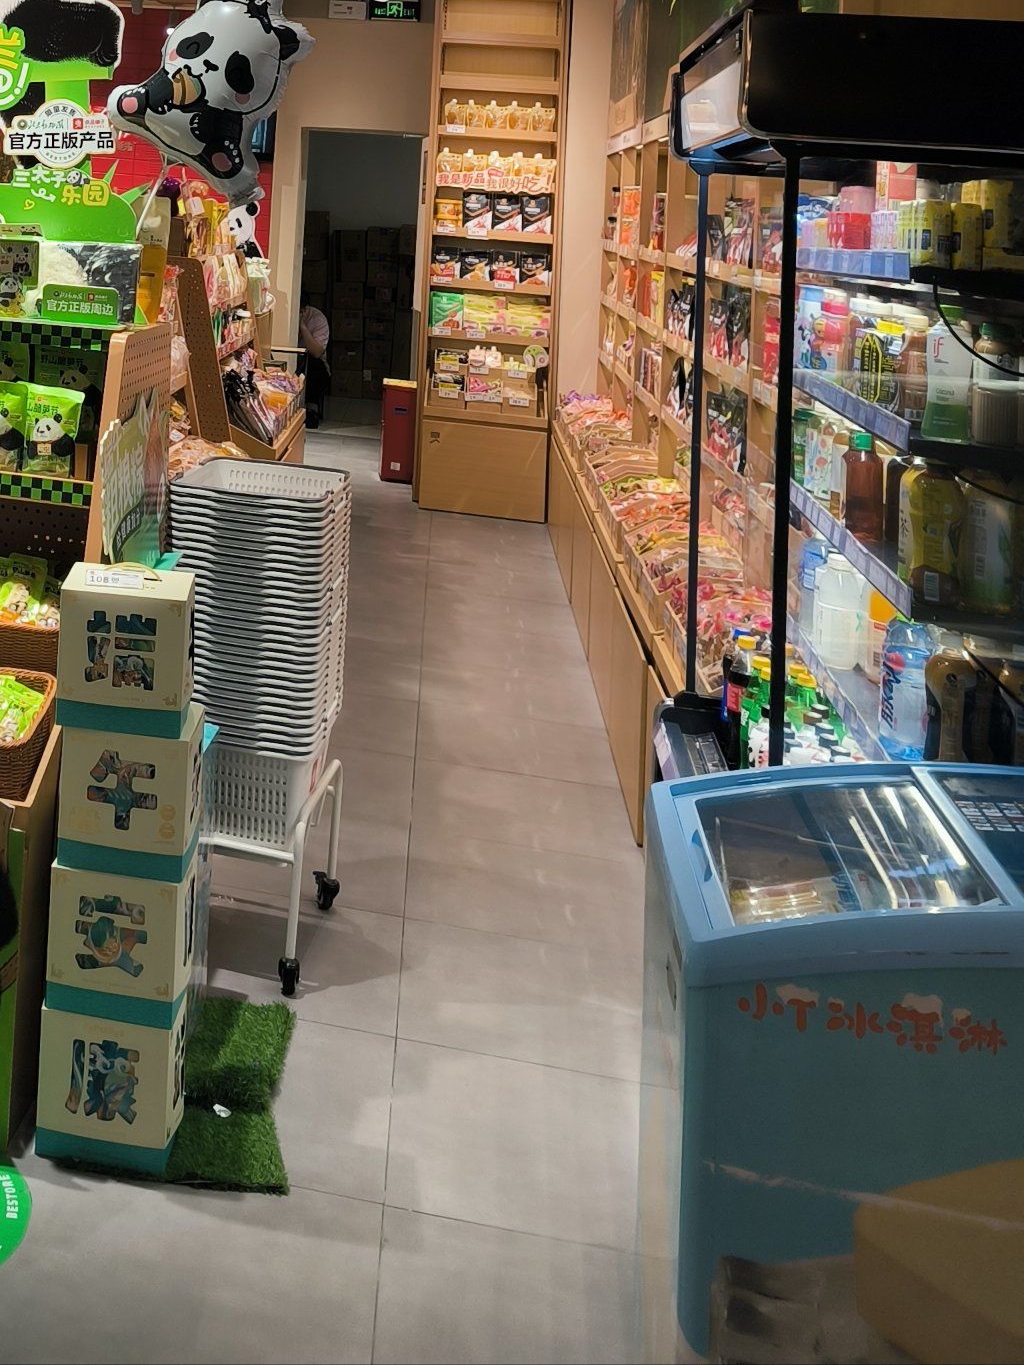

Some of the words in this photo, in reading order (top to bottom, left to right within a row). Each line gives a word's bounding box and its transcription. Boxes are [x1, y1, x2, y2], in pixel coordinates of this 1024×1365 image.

[8, 131, 114, 150] 官方正版产品
[60, 180, 110, 207] 乐园
[46, 298, 114, 316] 官方正版周边
